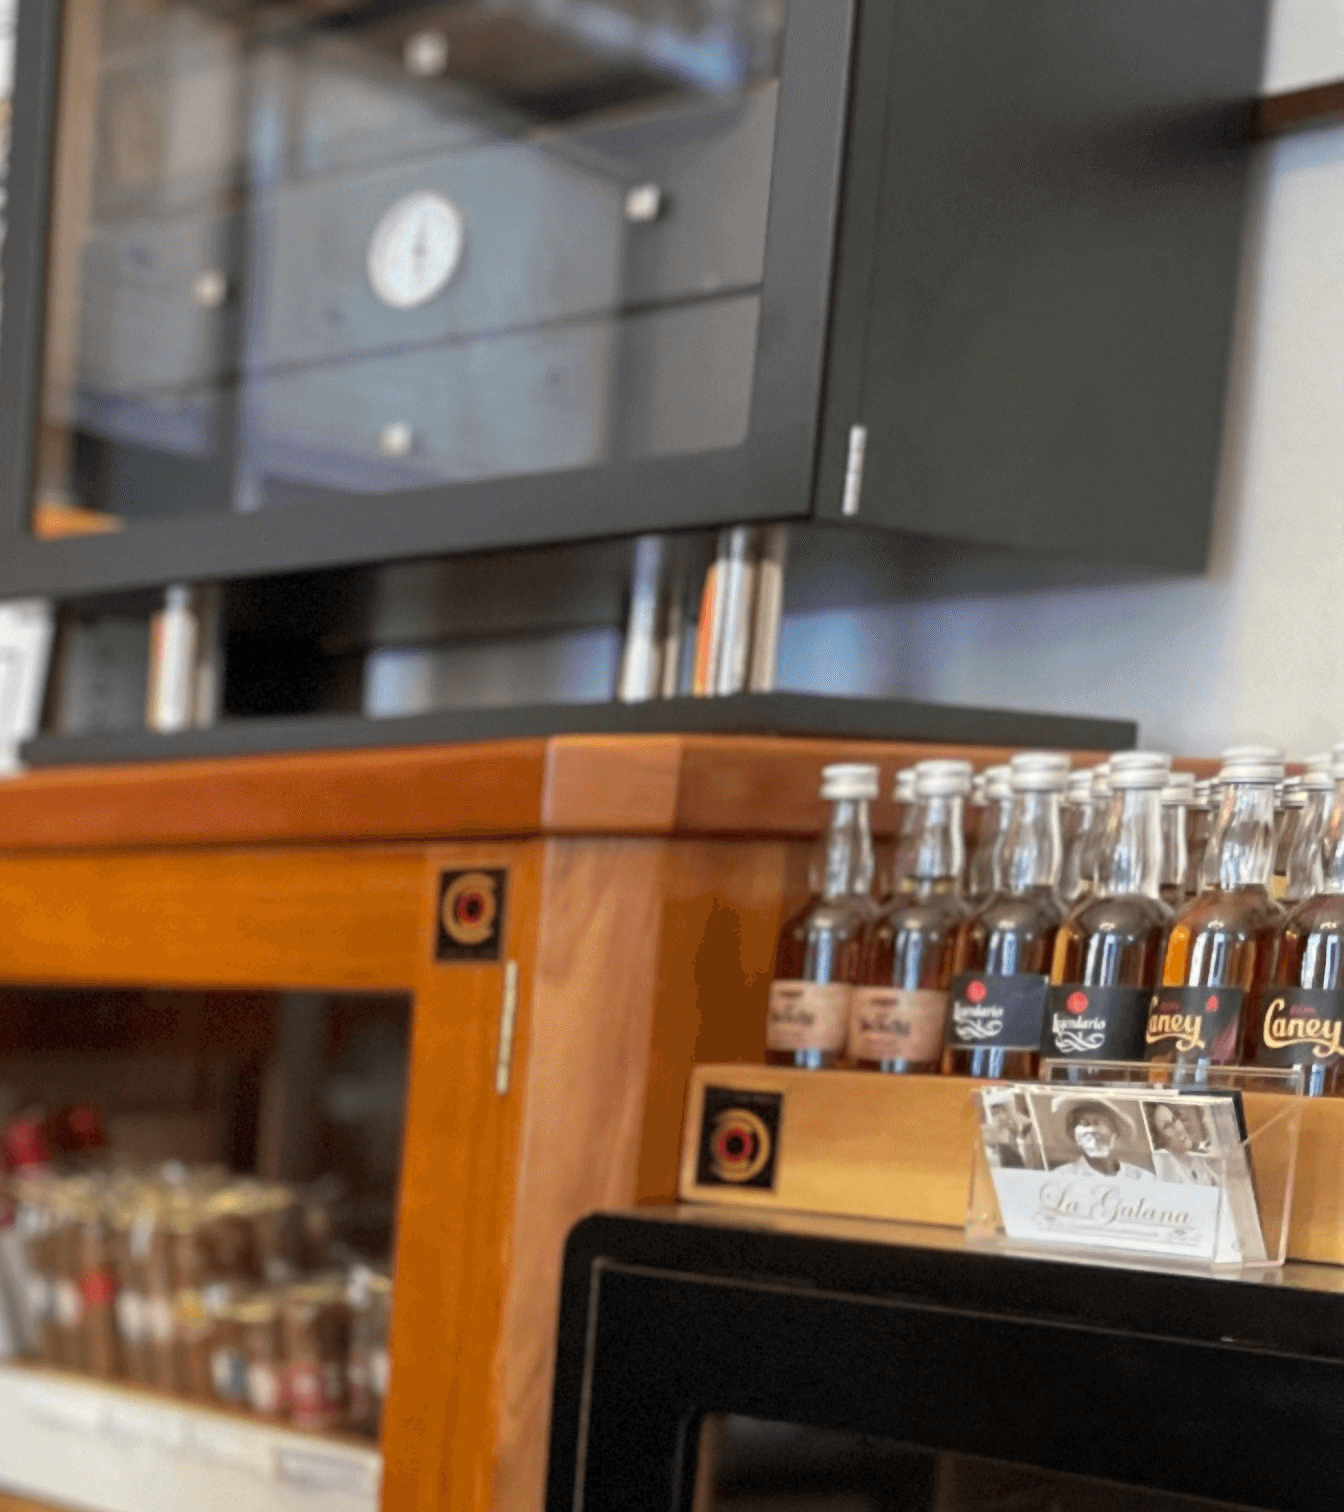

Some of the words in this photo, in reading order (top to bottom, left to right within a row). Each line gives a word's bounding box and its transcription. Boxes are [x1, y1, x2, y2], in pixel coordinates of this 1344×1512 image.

[1263, 998, 1344, 1058] Caney
[1039, 1180, 1079, 1214] La
[1090, 1183, 1193, 1225] Galana
